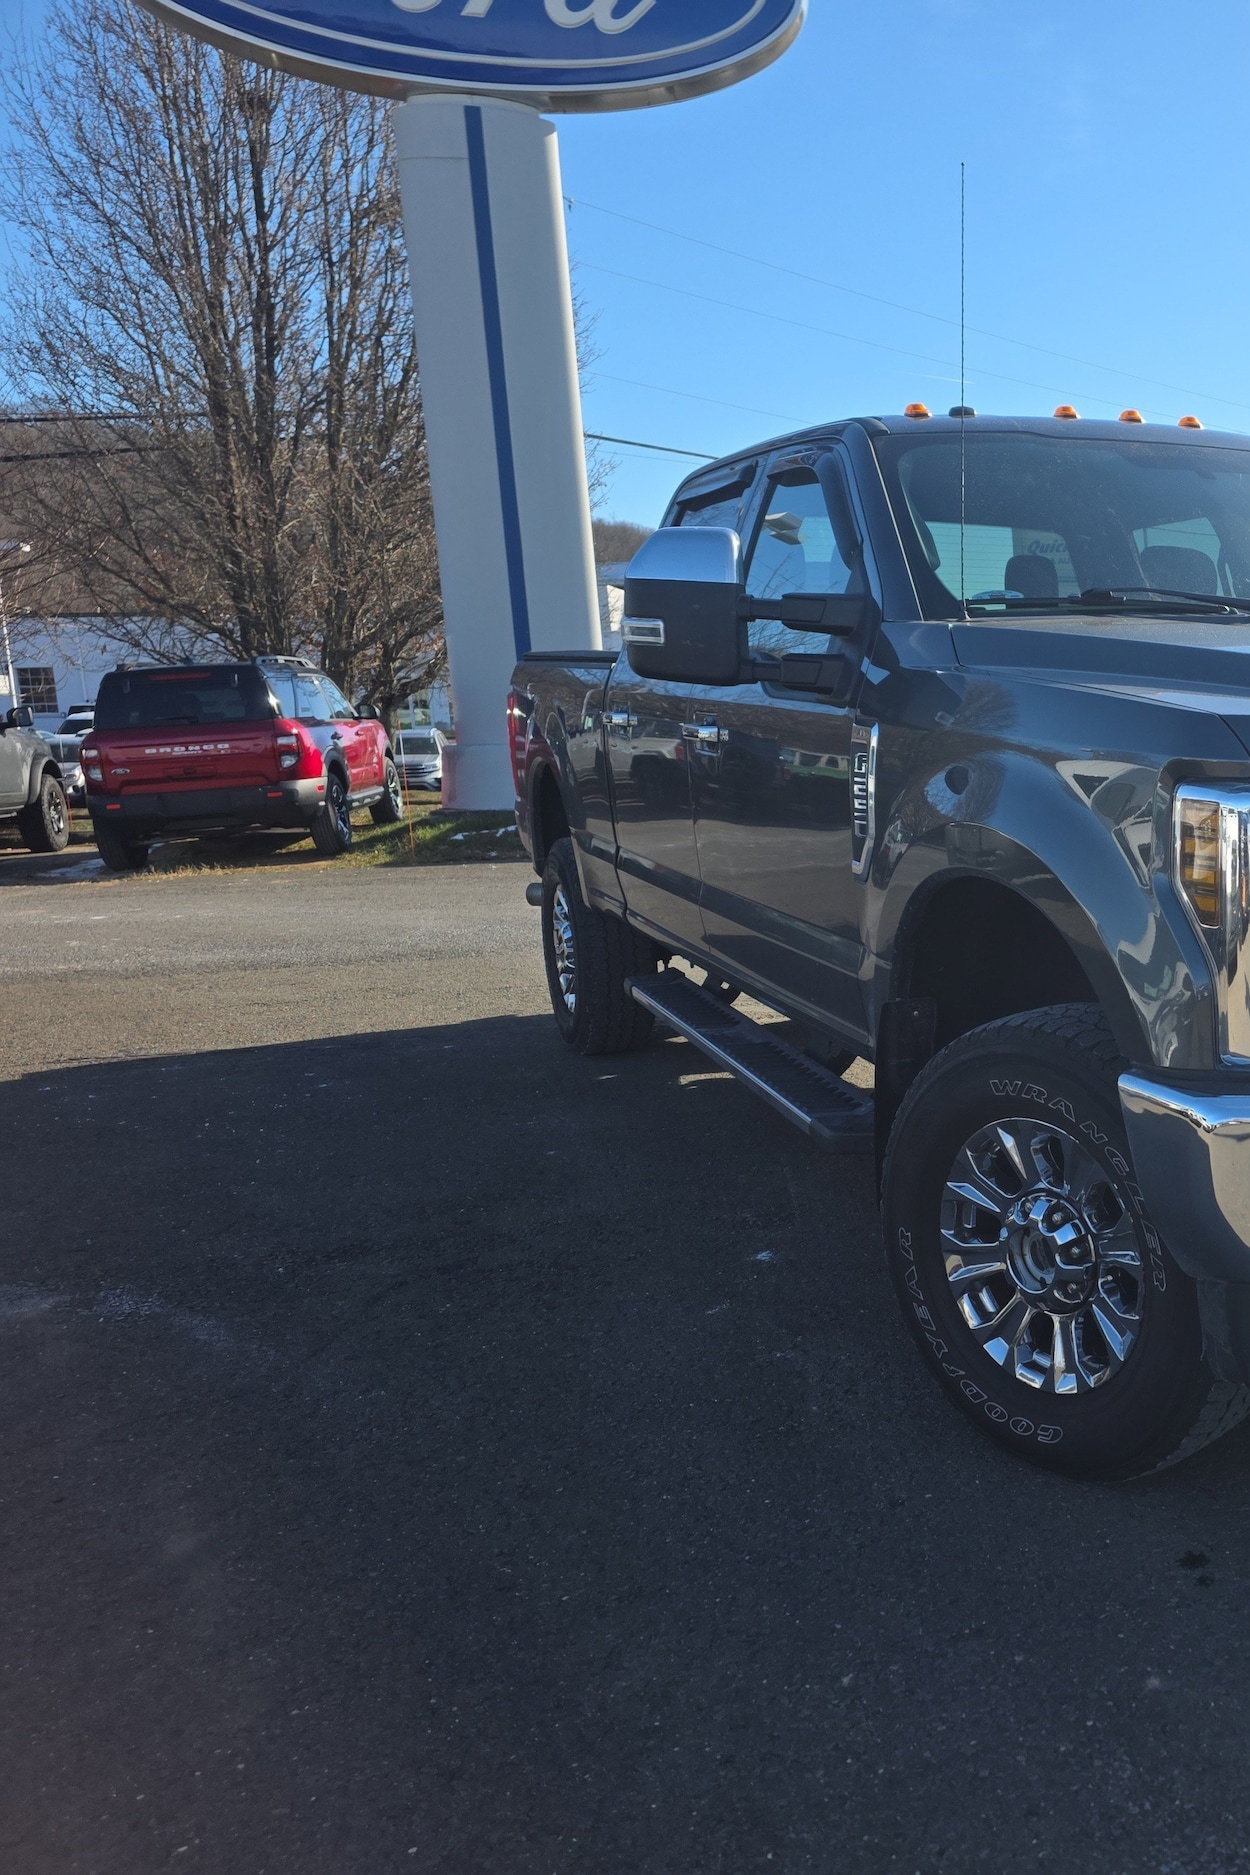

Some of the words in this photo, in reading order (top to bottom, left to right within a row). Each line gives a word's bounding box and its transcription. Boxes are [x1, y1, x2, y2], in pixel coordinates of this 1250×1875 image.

[145, 743, 229, 754] BRONCO
[990, 1080, 1166, 1291] WRANGLER
[899, 1227, 1063, 1443] GOODYEAR
